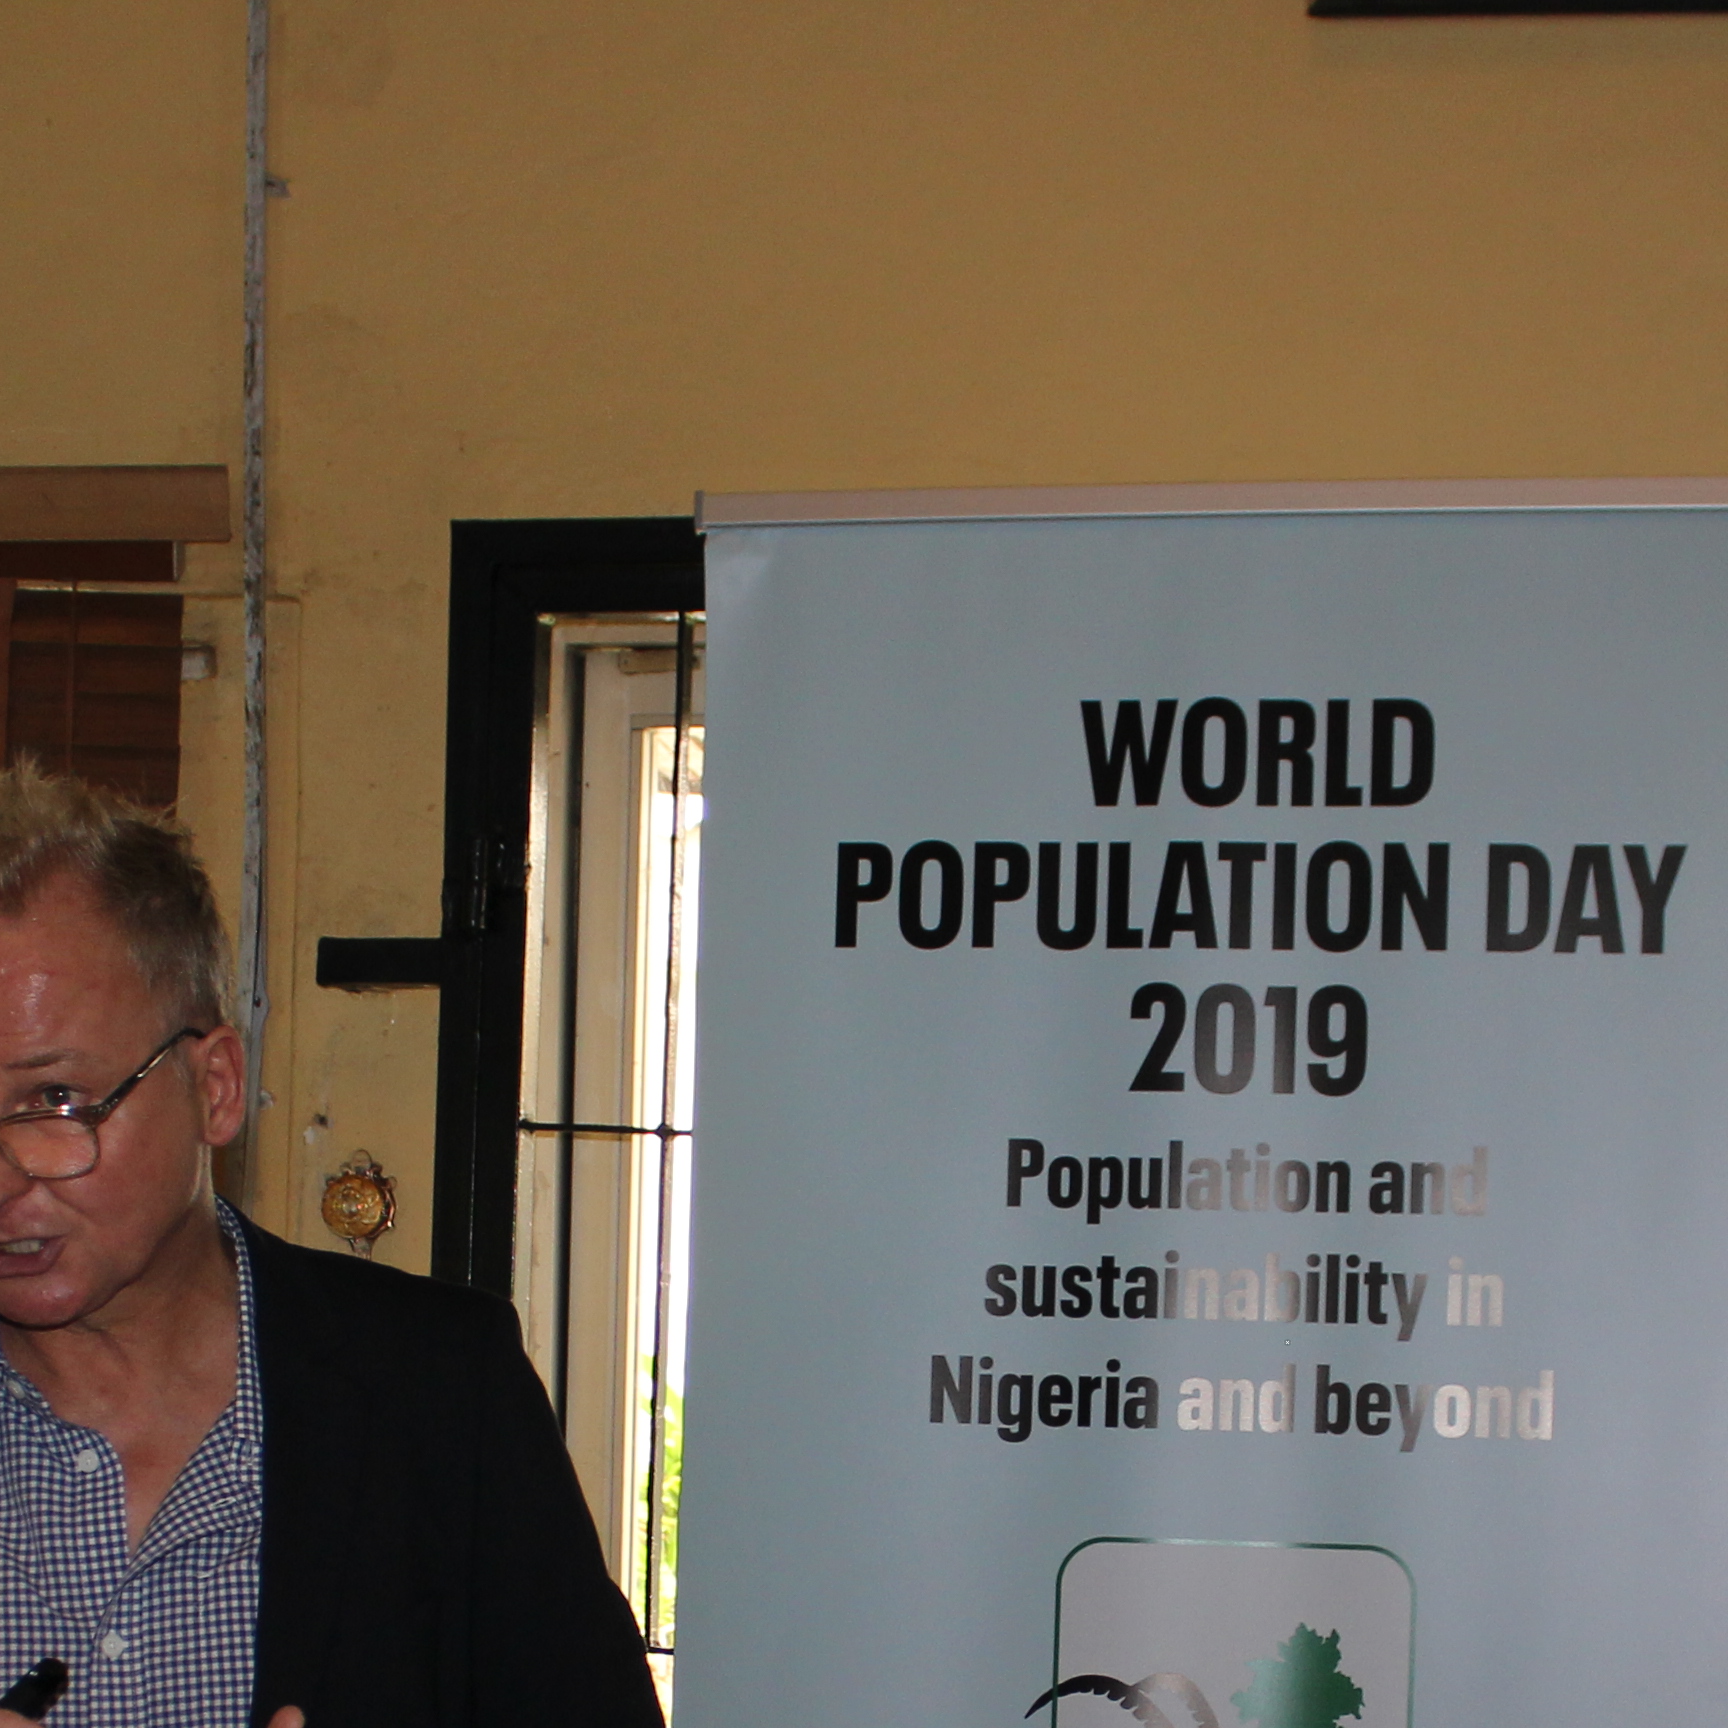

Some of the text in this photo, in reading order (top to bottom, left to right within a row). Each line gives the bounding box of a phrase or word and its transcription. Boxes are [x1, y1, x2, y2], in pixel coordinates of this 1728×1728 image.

[1080, 696, 1436, 808] WORLD
[834, 840, 1688, 956] POPULATION DAY
[1128, 981, 1368, 1098] 2019
[1006, 1139, 1489, 1225] Population and
[983, 1250, 1504, 1341] sustainability in
[928, 1354, 1555, 1454] Nigeria and beyond
